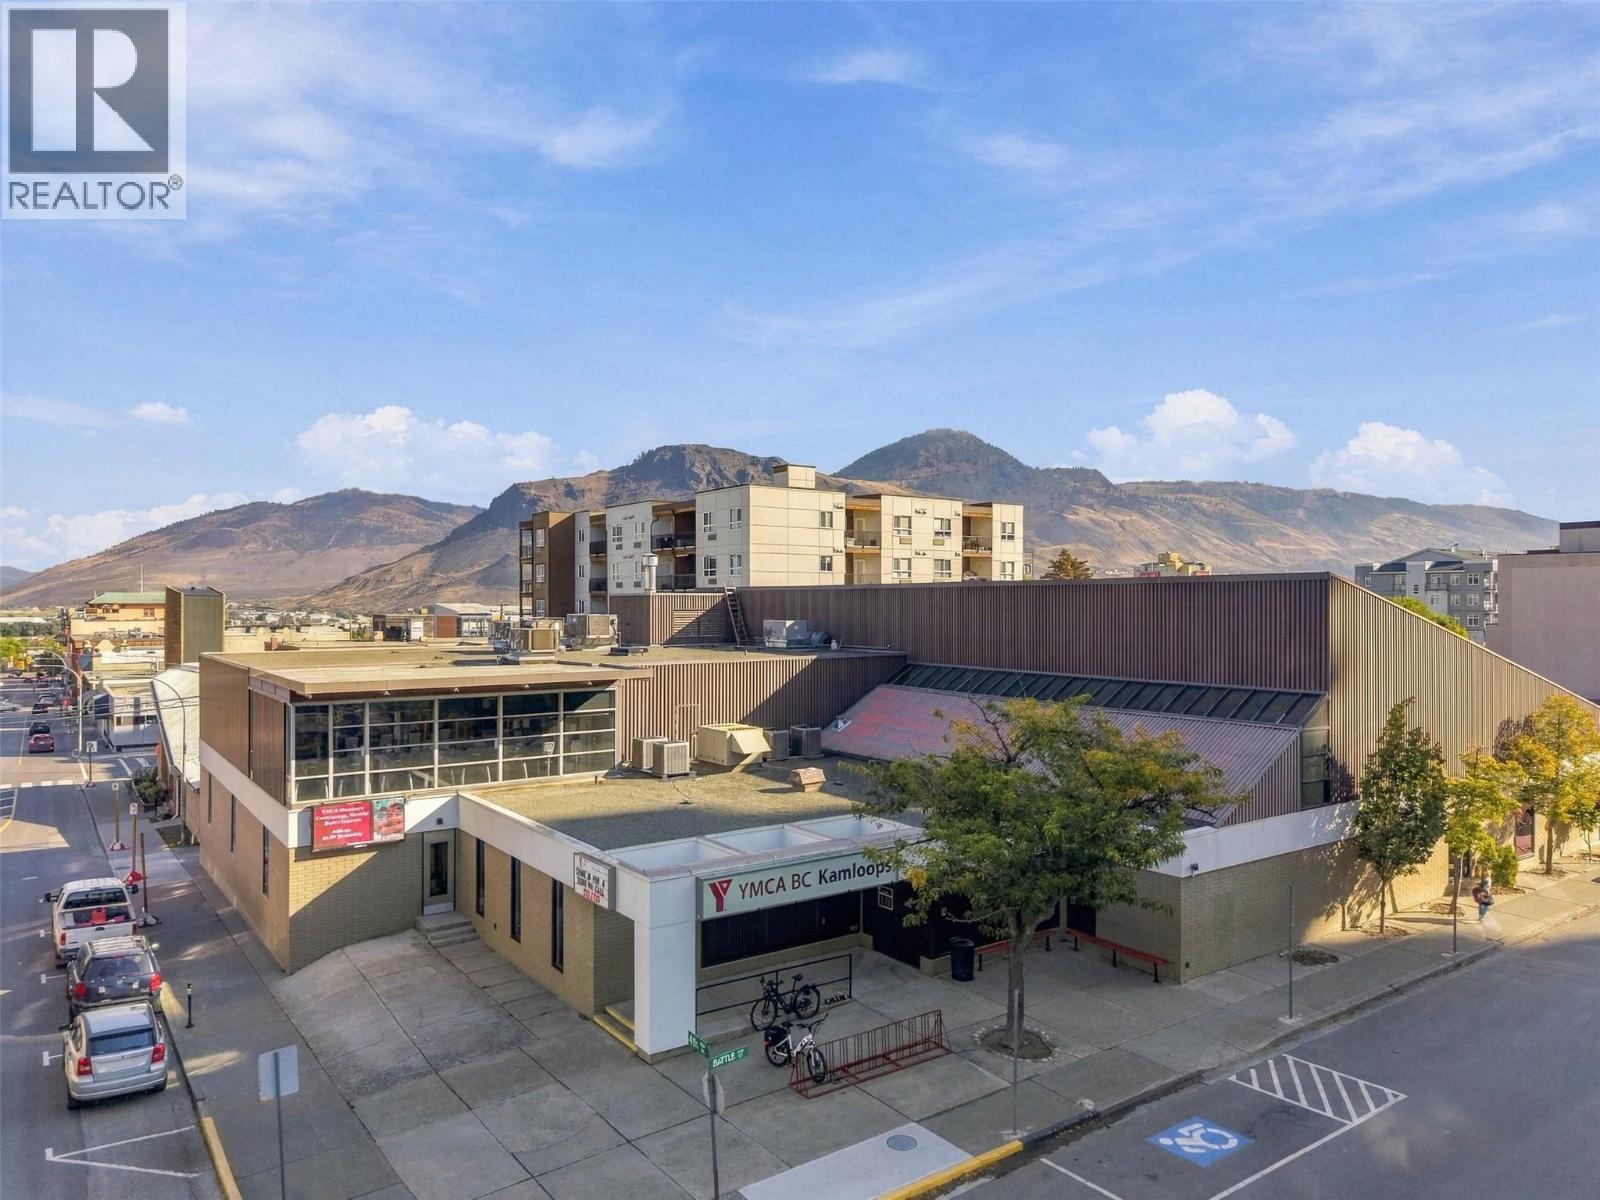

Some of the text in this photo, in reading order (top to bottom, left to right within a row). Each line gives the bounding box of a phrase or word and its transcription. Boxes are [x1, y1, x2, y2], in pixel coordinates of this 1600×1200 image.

[738, 862, 892, 900] YMCA BC Kamloops
[712, 1052, 736, 1067] BATTLE
